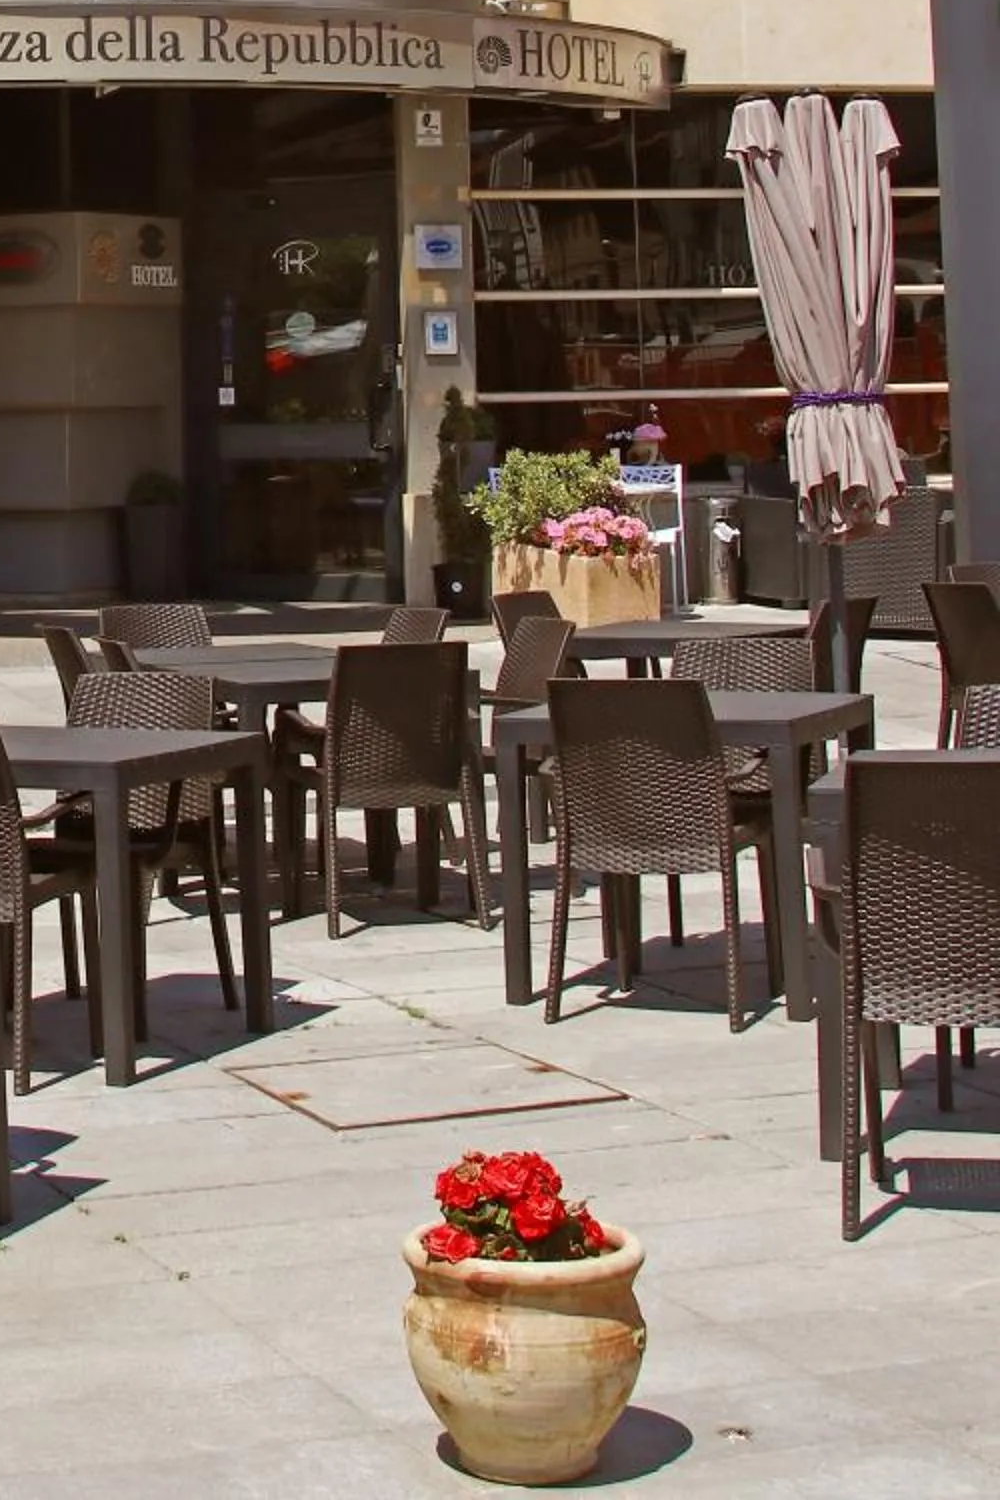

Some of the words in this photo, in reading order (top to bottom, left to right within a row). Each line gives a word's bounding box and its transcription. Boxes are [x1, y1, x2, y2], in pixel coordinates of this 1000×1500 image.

[65, 15, 184, 63] della
[199, 16, 445, 75] Repubblica
[517, 29, 625, 87] HOTEL
[131, 265, 178, 287] HOTEL
[708, 264, 758, 287] HO
